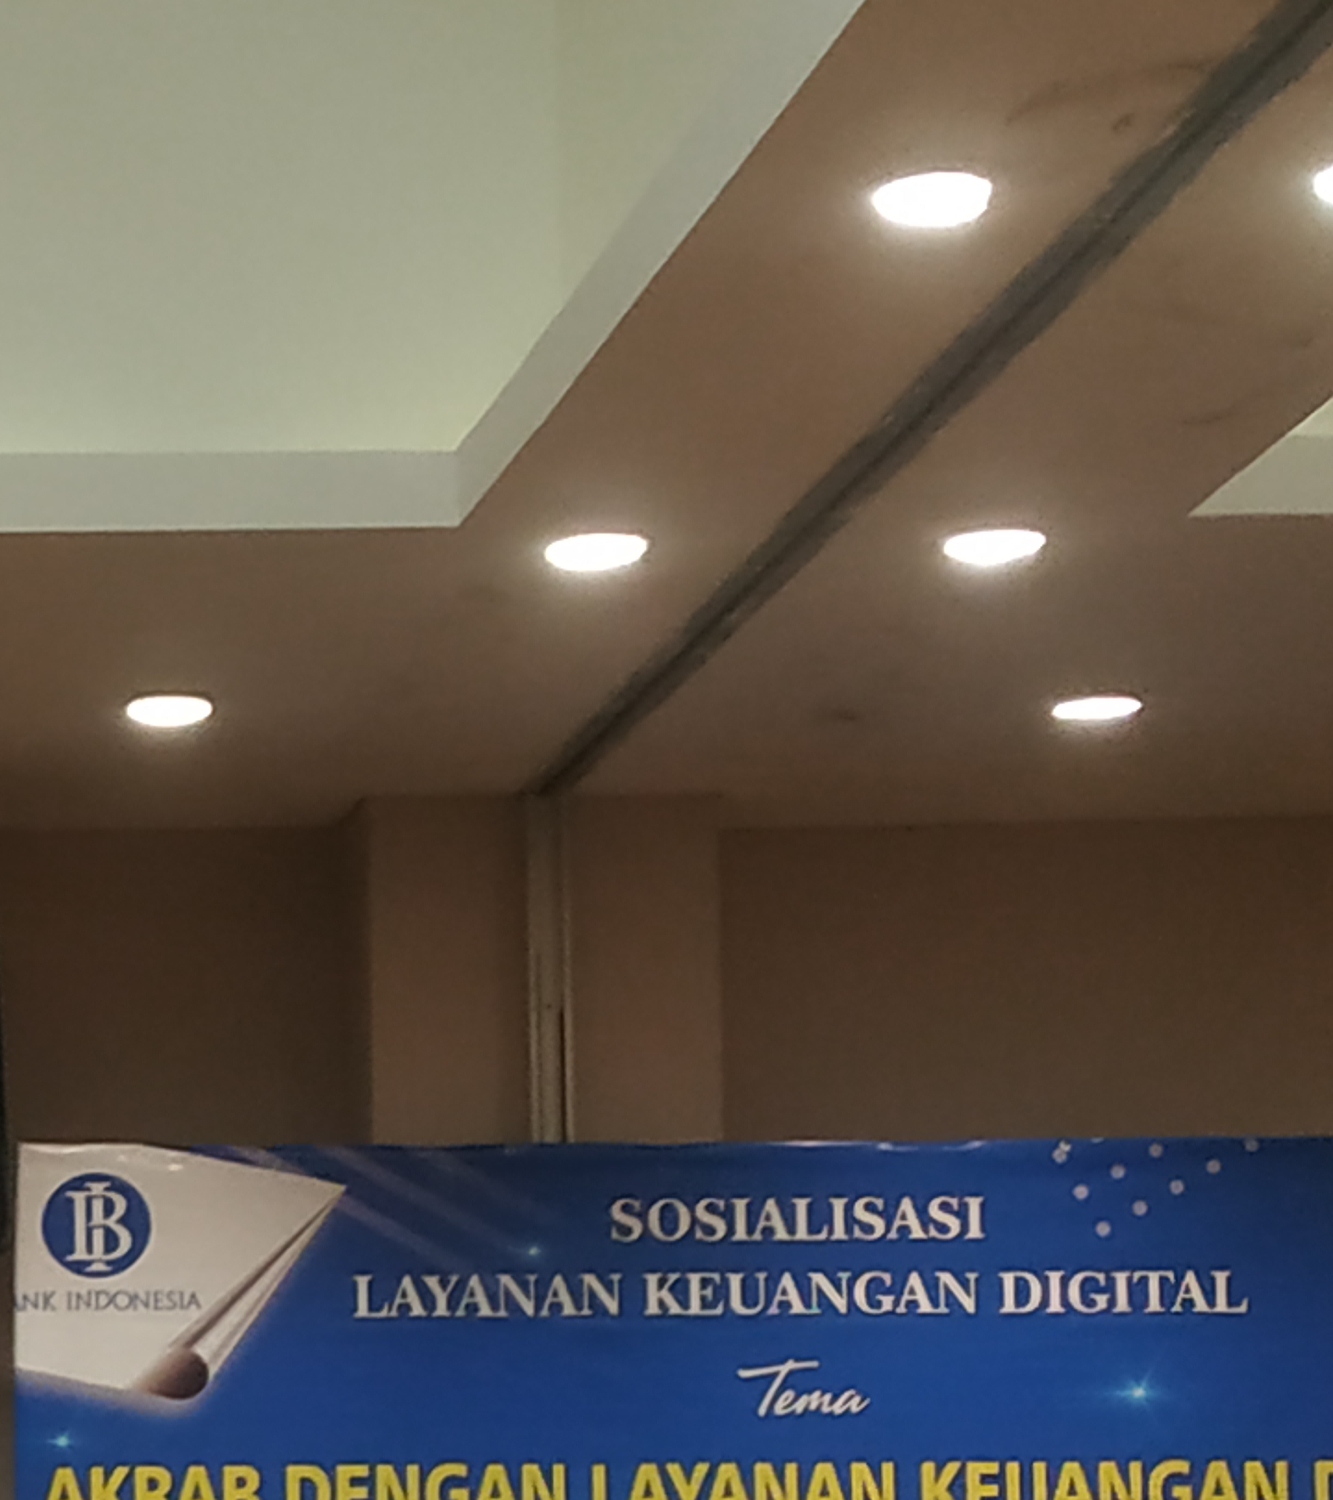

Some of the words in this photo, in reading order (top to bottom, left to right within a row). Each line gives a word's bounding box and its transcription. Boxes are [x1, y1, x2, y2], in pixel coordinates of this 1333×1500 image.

[611, 1195, 985, 1241] SOSIALISASI
[66, 1289, 202, 1312] INDONESIA
[353, 1273, 622, 1319] LAYANAN
[644, 1271, 979, 1316] KEUANGAN
[998, 1270, 1248, 1314] DIGITAL
[737, 1359, 870, 1417] Tema
